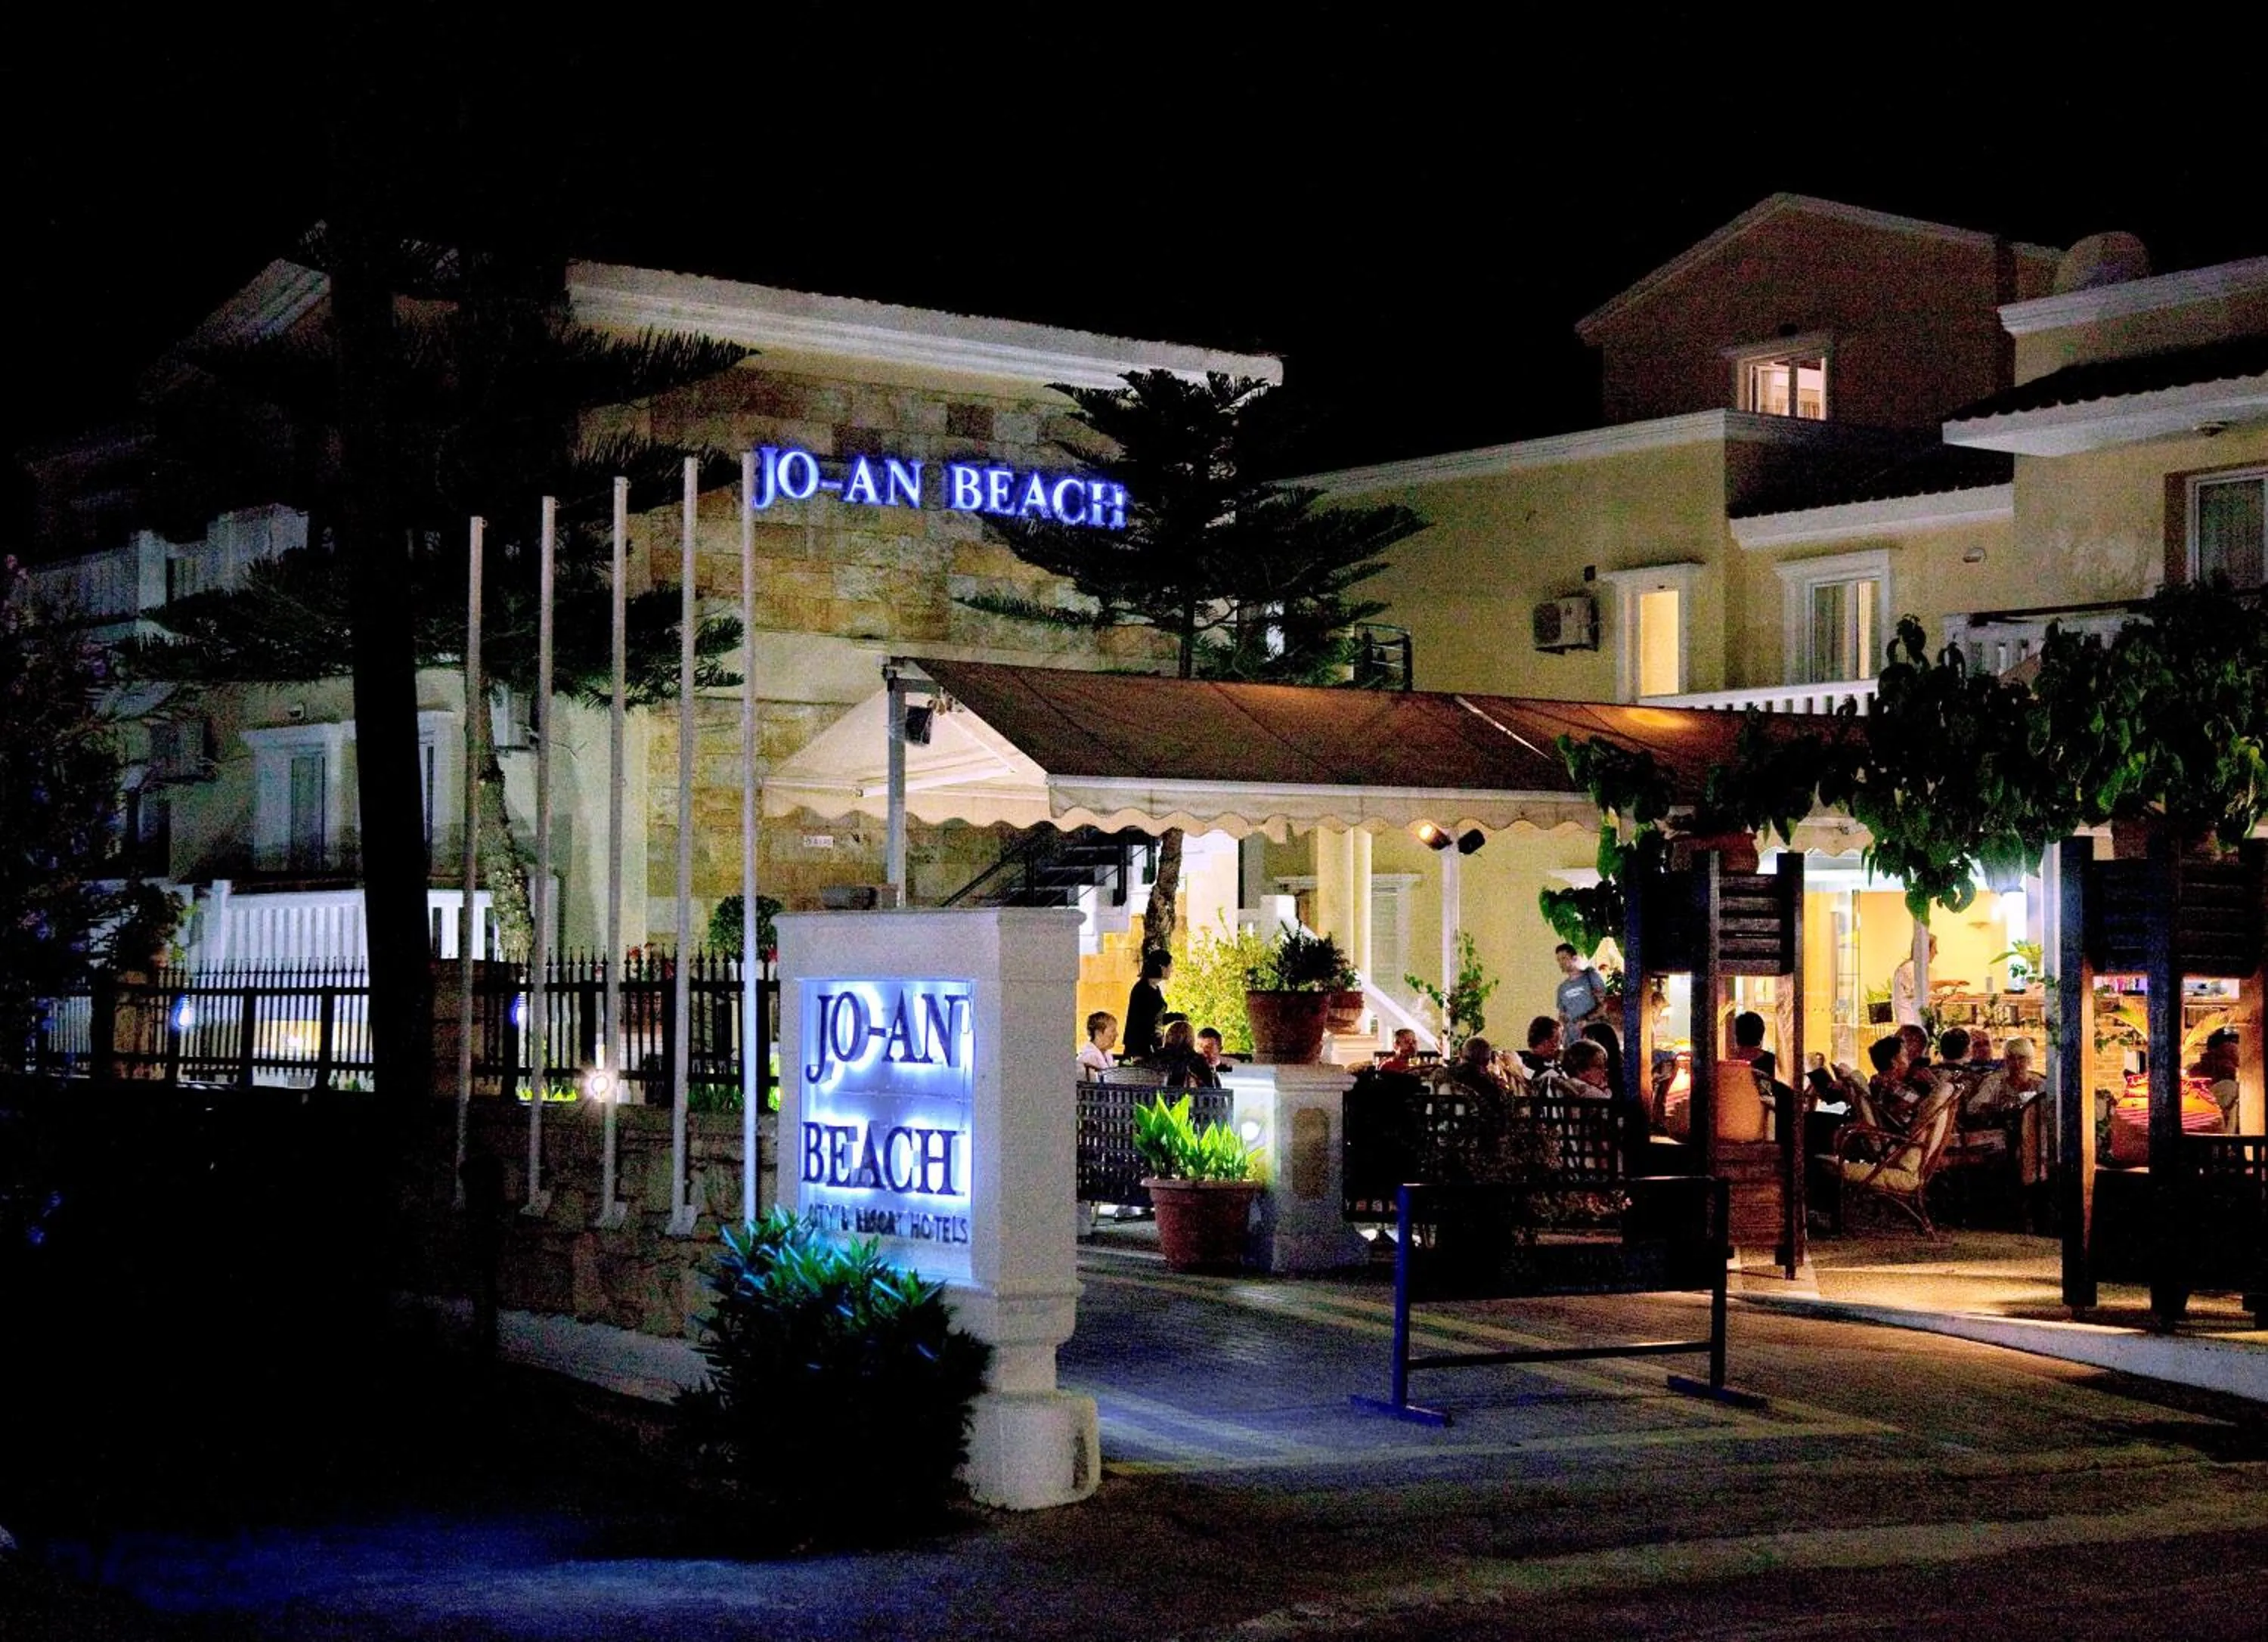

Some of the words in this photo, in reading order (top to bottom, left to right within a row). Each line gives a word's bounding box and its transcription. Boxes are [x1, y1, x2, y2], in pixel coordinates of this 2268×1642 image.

[753, 447, 923, 510] JO-AN
[951, 464, 1126, 528] BEACH
[806, 989, 968, 1084] JO-AN
[802, 1121, 960, 1196] BEACH
[909, 1212, 968, 1244] HOTELS
